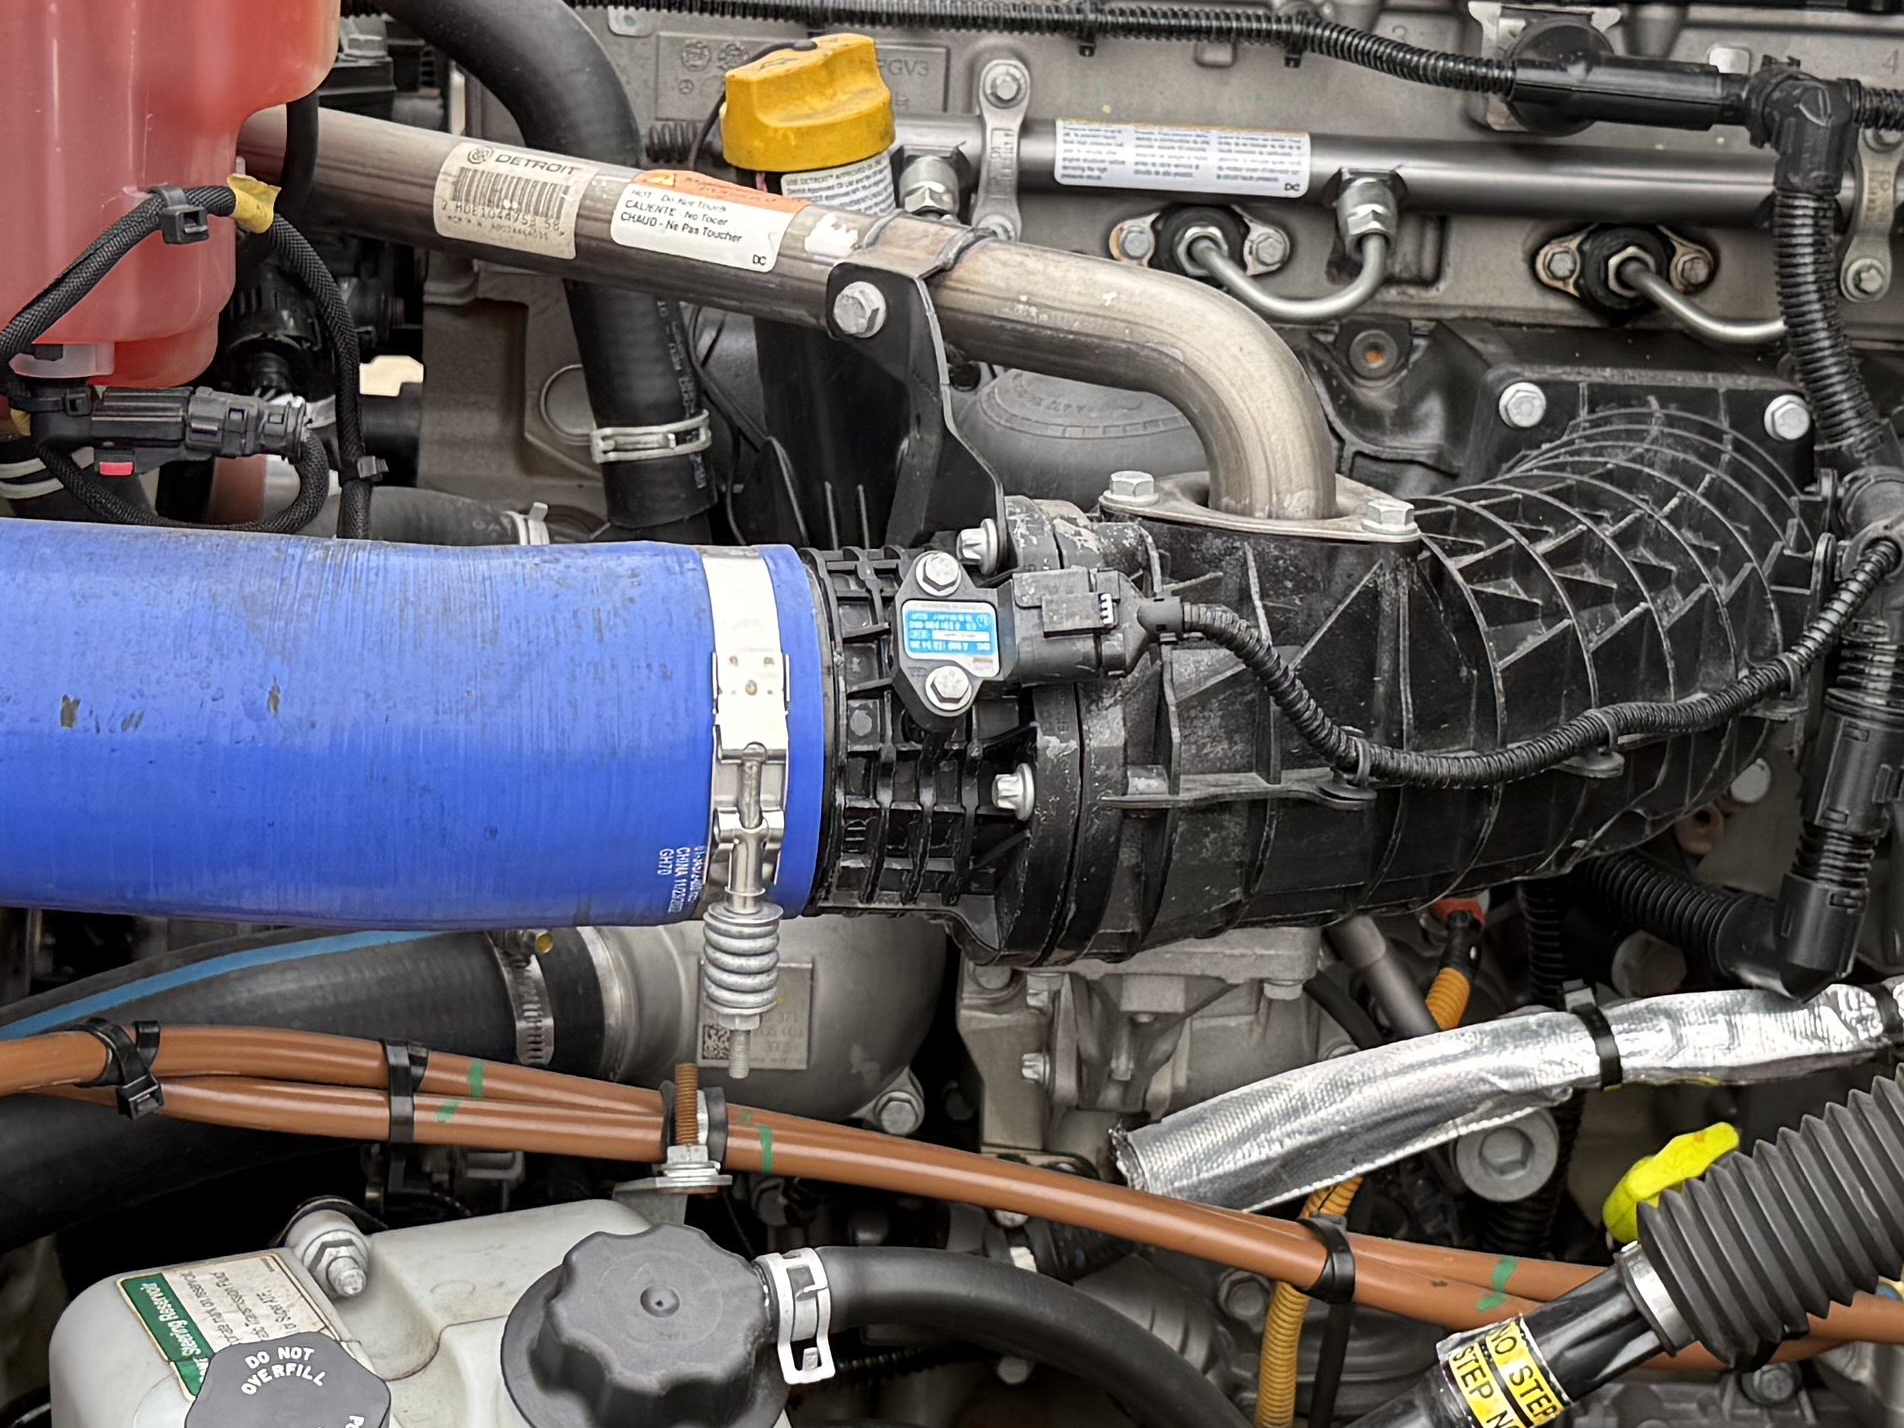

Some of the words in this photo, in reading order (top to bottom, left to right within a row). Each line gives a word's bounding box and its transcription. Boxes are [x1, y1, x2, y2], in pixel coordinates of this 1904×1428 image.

[494, 150, 579, 179] DETROIT
[620, 211, 658, 227] CHAUD
[665, 219, 679, 232] Ne
[625, 198, 676, 218] CALIENTE
[657, 848, 674, 875] GH70
[212, 1268, 232, 1288] Fluid
[140, 1281, 176, 1322] Reservoir
[268, 1302, 289, 1325] Super
[167, 1319, 202, 1357] Steering
[244, 1349, 271, 1368] DO
[277, 1346, 315, 1363] NOT
[241, 1362, 327, 1398] OVERFILL
[1455, 1344, 1496, 1399] STEP
[1488, 1325, 1517, 1356] NO
[1510, 1363, 1558, 1422] STEP
